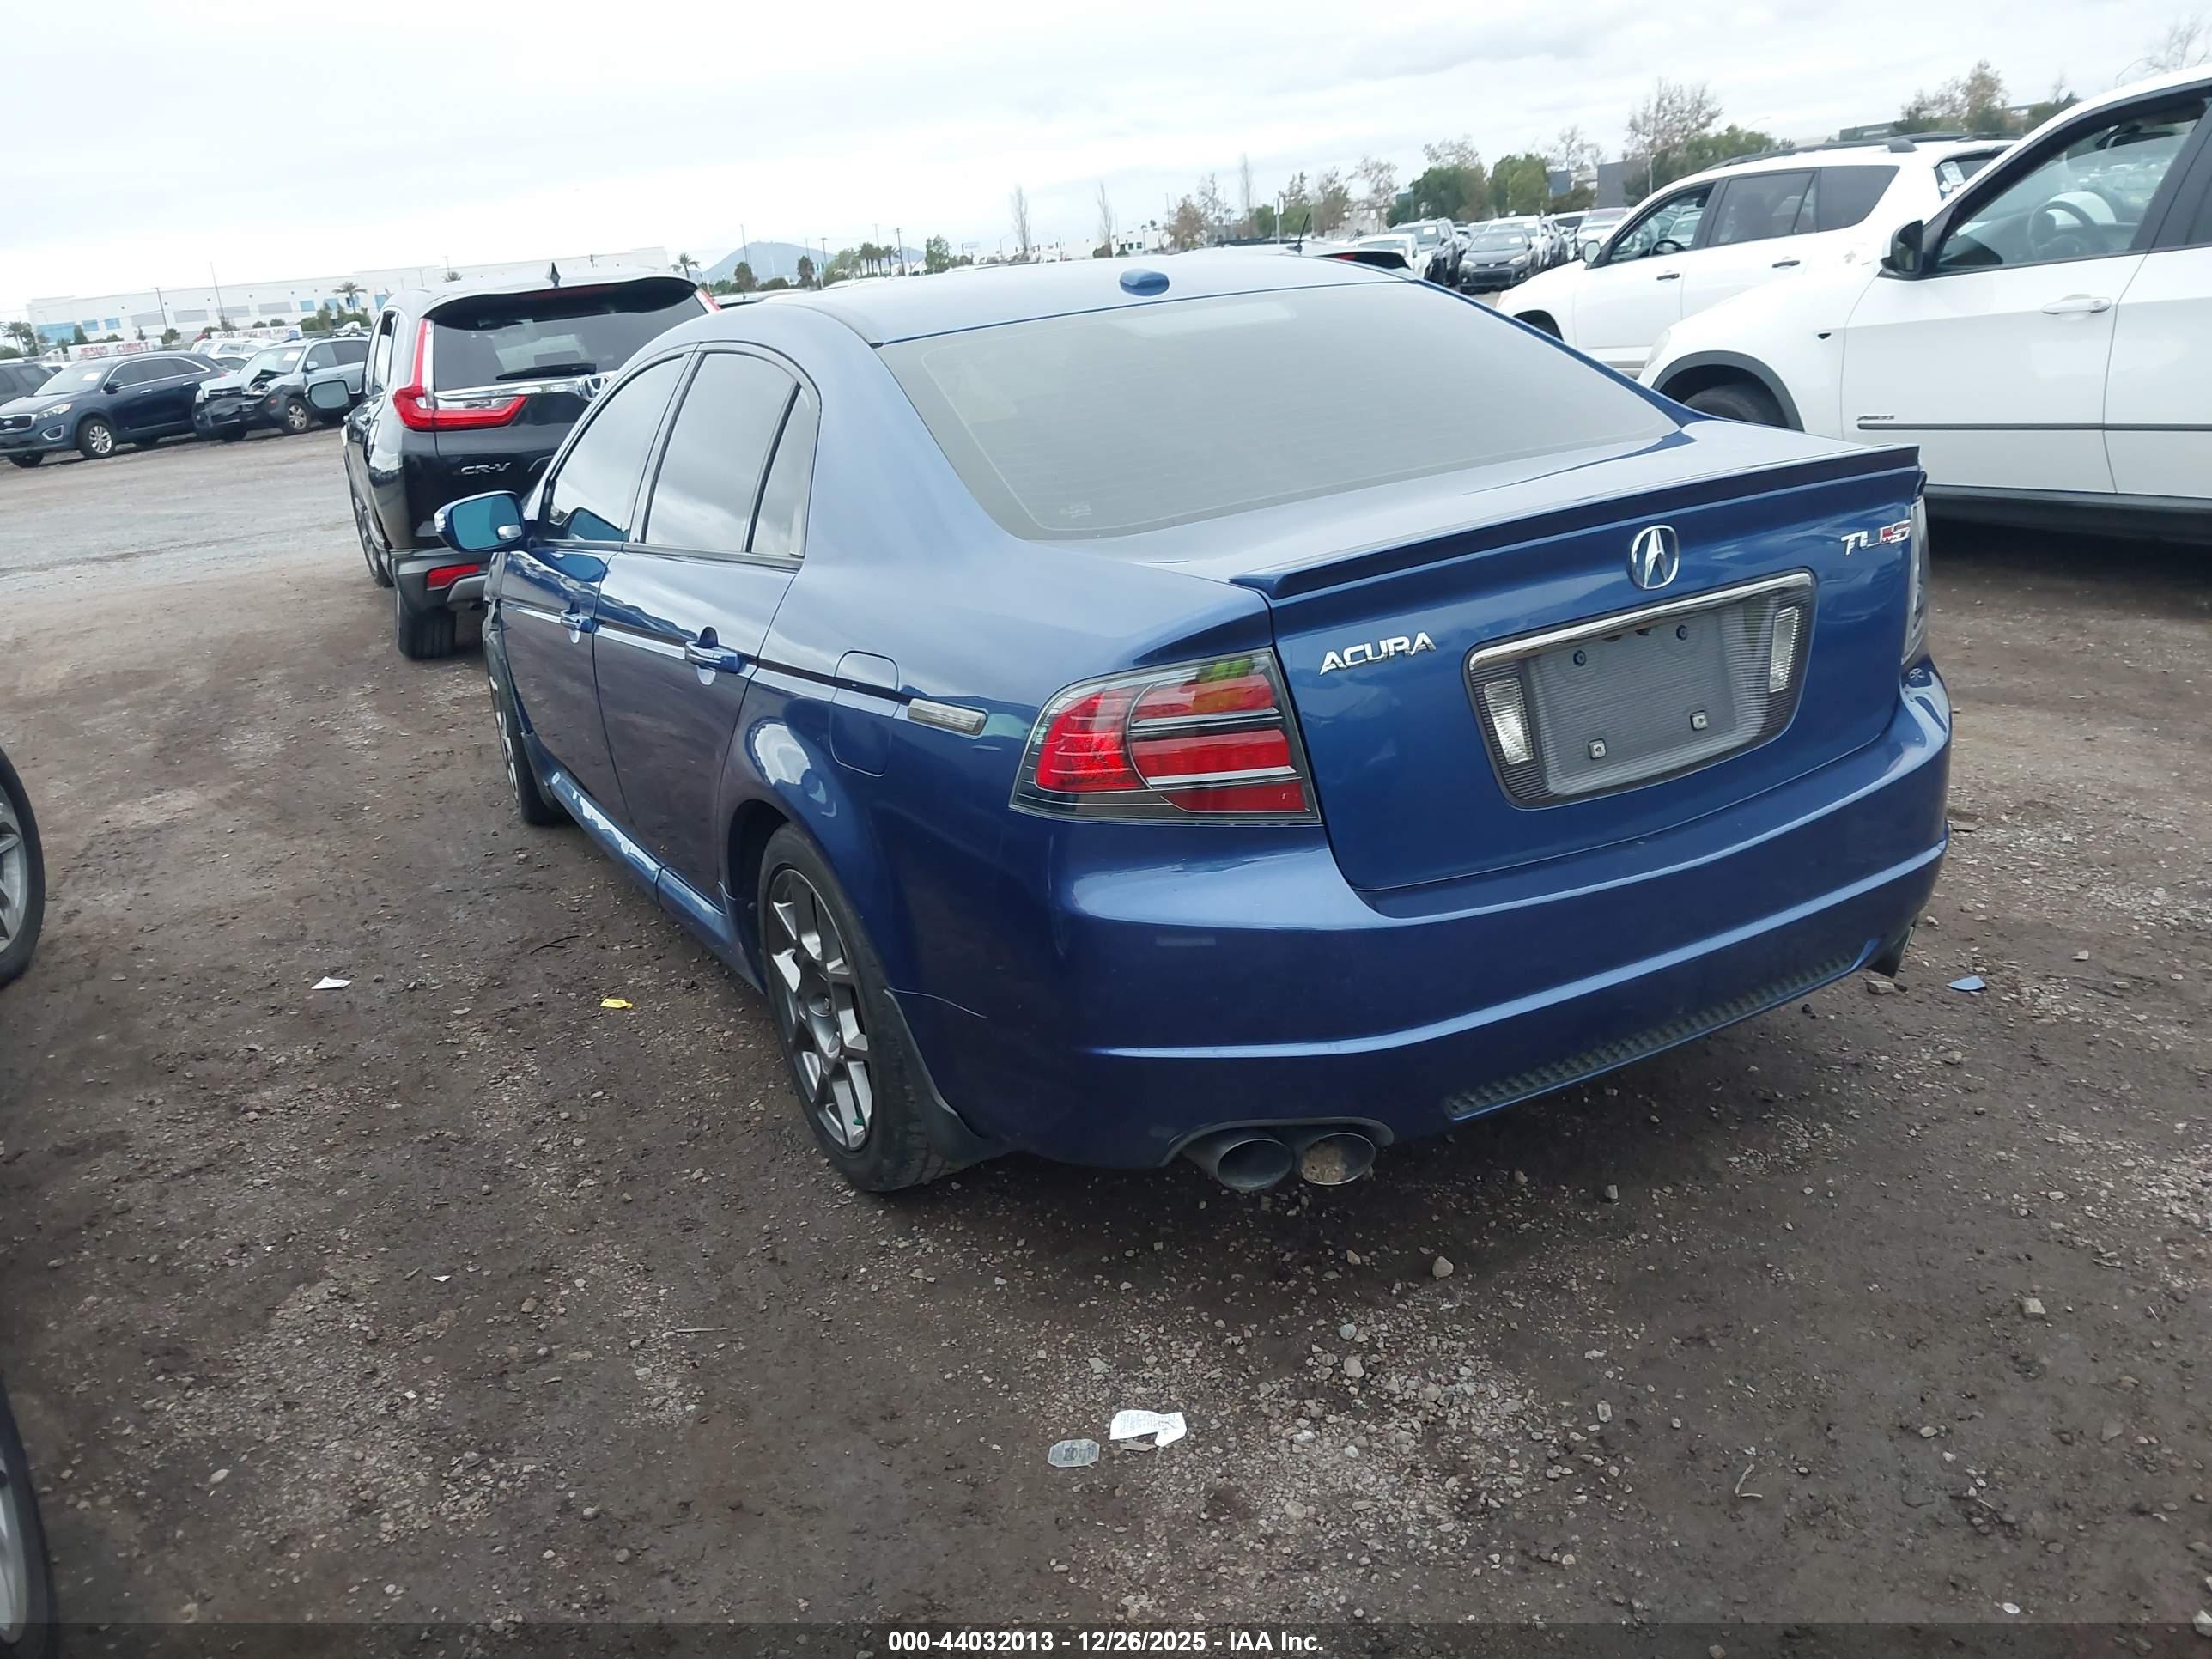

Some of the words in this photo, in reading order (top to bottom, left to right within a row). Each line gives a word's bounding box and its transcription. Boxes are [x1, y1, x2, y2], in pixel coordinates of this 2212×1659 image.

[80, 345, 108, 357] JESUS
[116, 342, 149, 354] CHRIST
[460, 462, 511, 475] CR-V
[1318, 631, 1437, 676] ACURA
